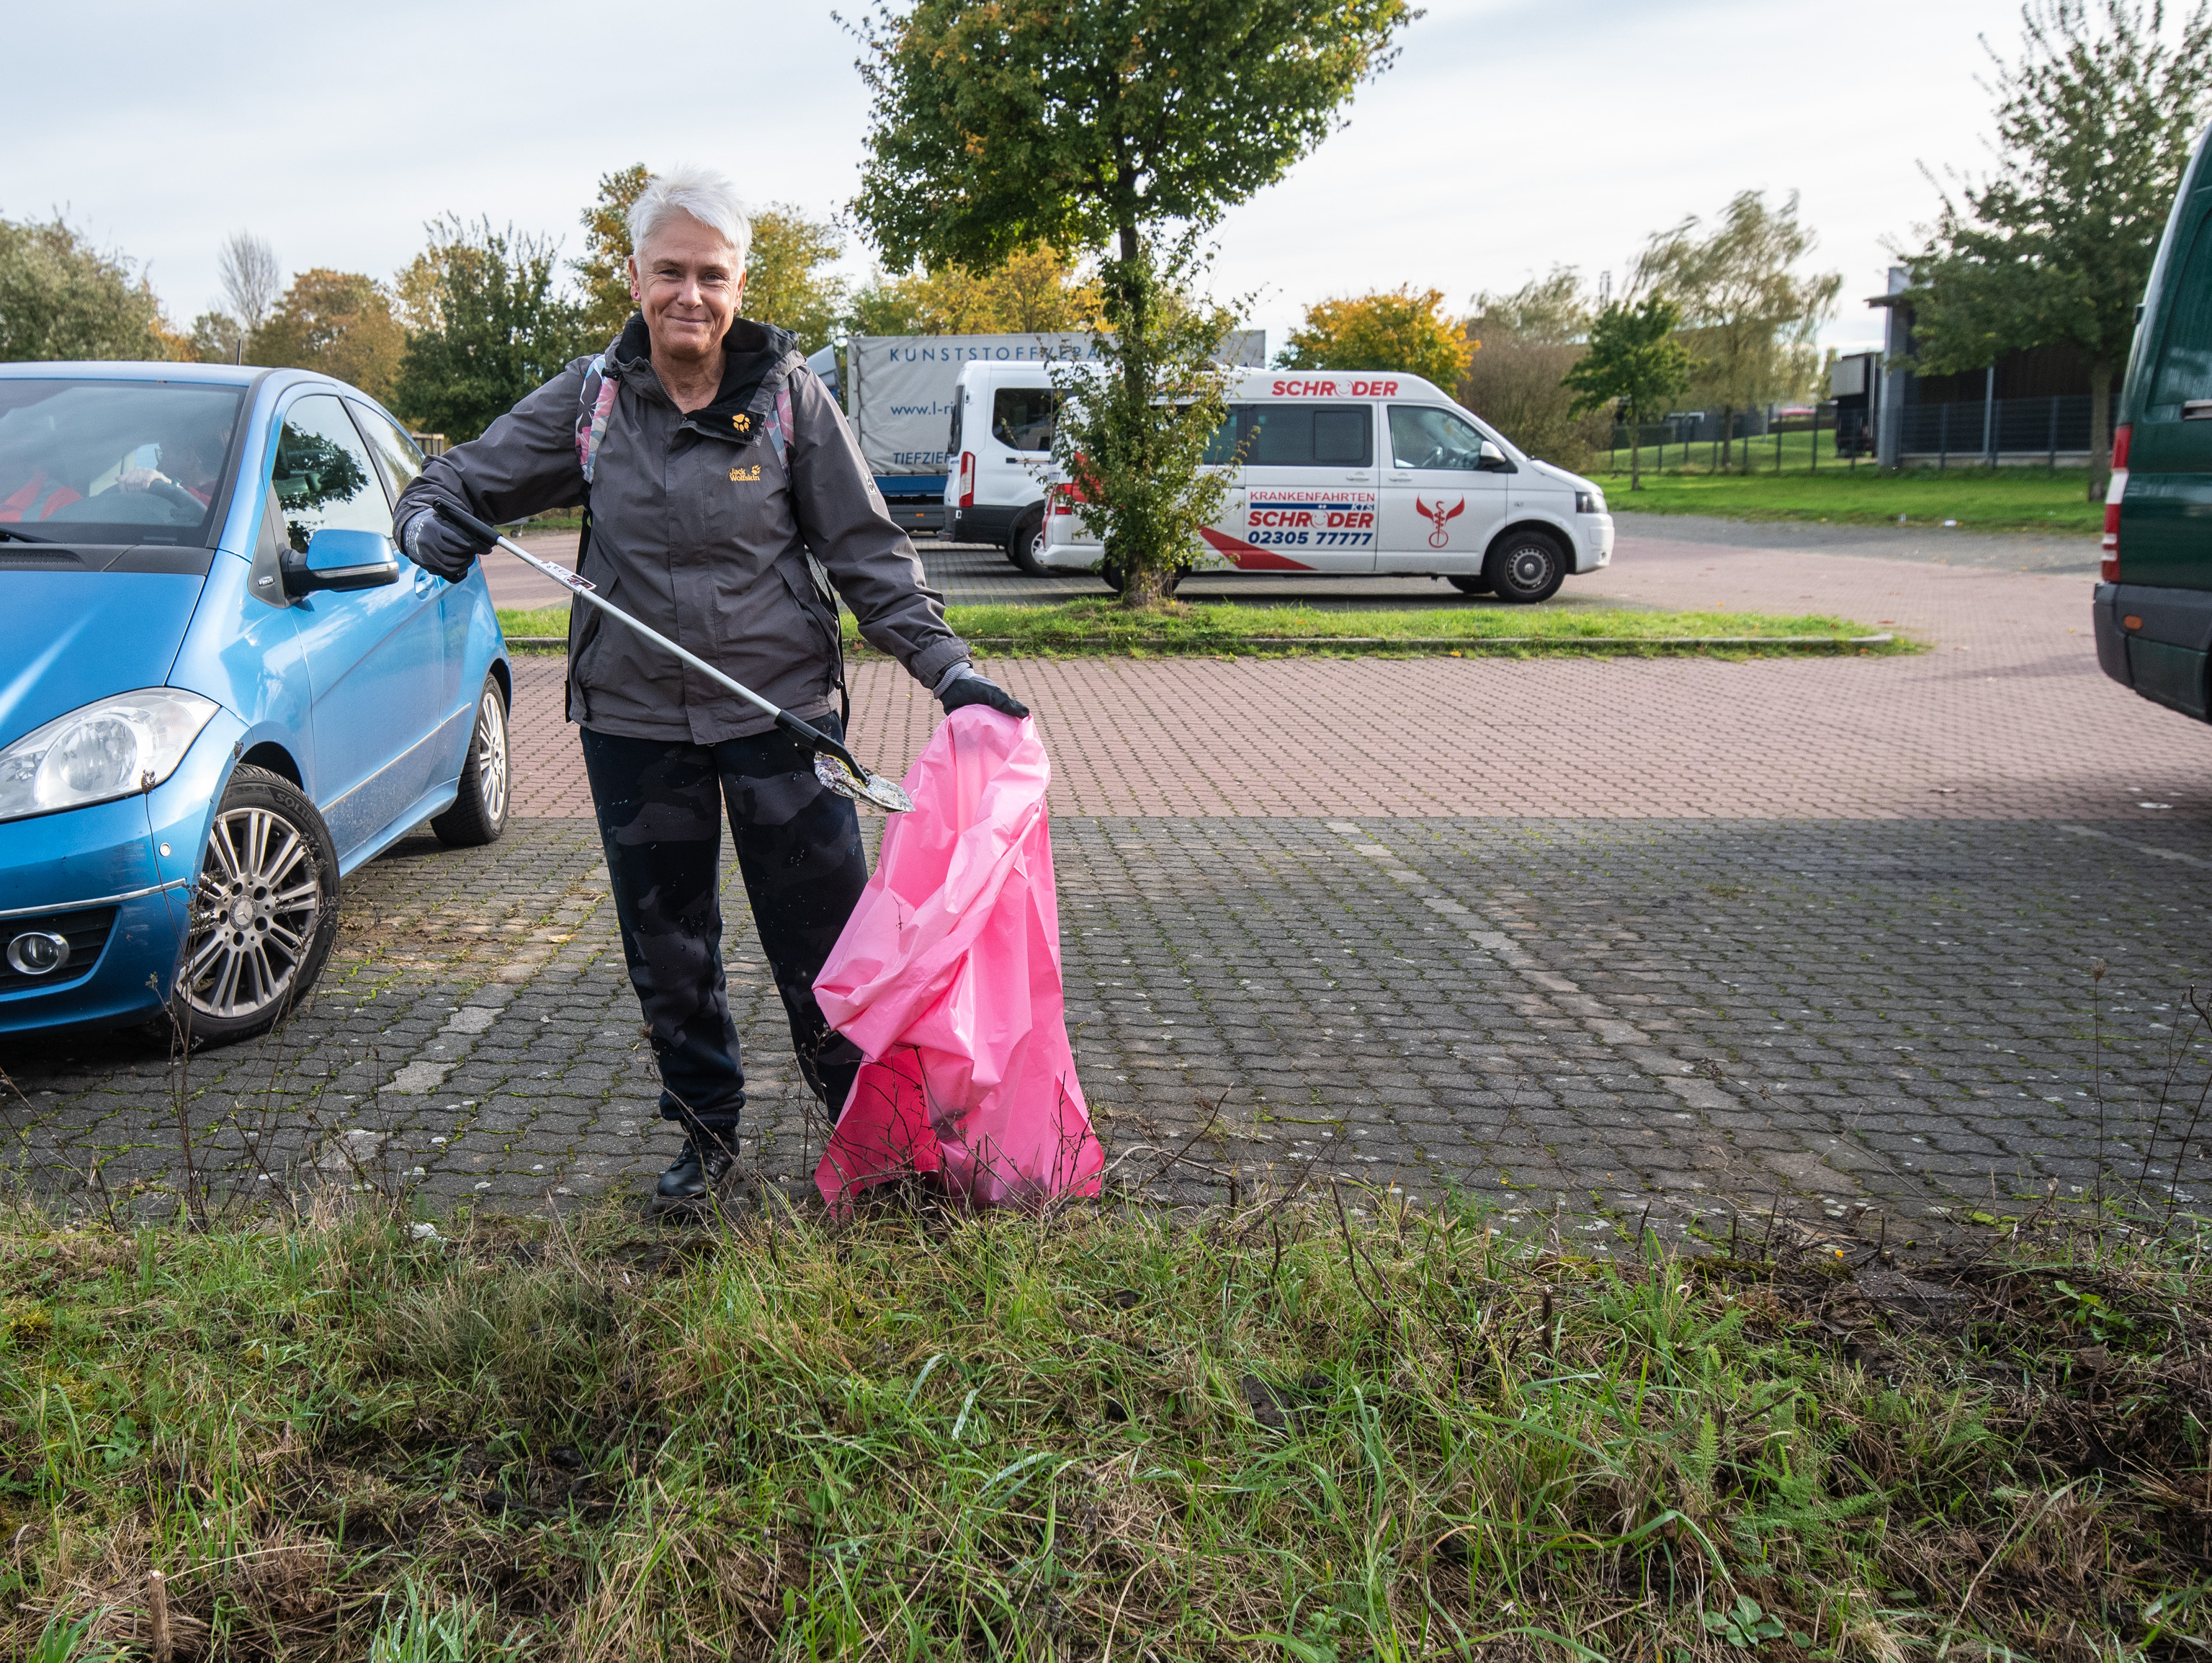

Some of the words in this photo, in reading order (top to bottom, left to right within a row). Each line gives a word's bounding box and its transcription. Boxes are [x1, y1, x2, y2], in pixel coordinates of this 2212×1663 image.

[890, 400, 956, 416] www.l-ri
[1250, 491, 1375, 503] KRANKENFAHRTEN
[1350, 503, 1374, 511] KTS
[1248, 531, 1309, 544] 02305
[1316, 532, 1374, 546] 77777
[276, 793, 317, 828] SOLUS
